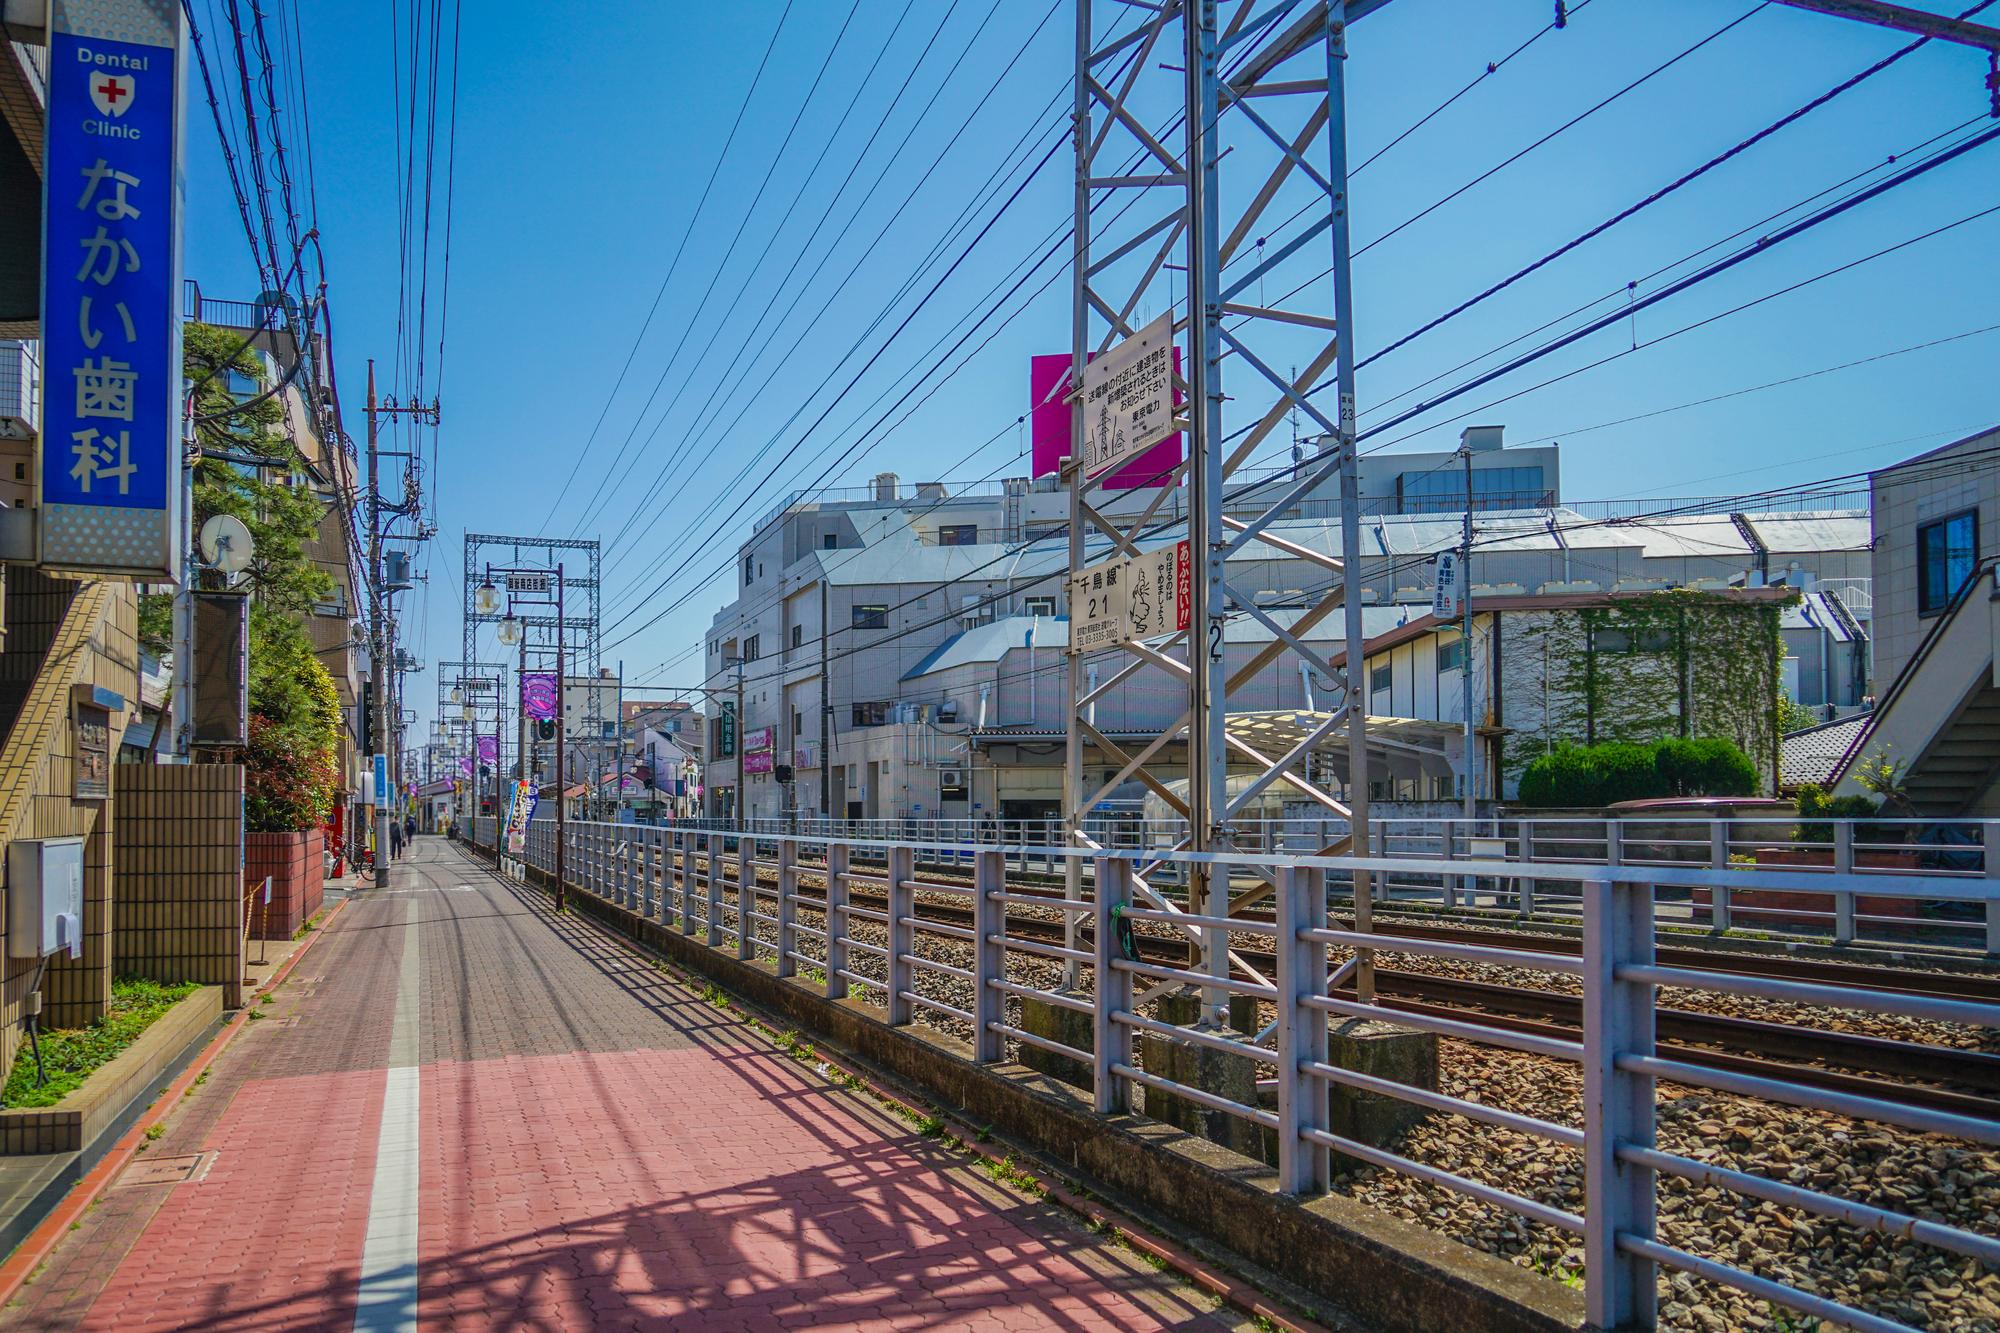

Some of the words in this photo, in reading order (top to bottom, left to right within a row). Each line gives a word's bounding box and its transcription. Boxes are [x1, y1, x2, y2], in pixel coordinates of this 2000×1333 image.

[77, 47, 148, 71] Dental
[82, 119, 141, 139] Clinic
[70, 158, 141, 495] なかい歯科
[1088, 346, 1166, 403] 送電線の付近に建造物を
[1120, 377, 1166, 412] お知らせ下さい
[1132, 400, 1160, 423] 東京電力
[1342, 407, 1353, 421] 23
[1088, 594, 1108, 619] 21
[1209, 625, 1221, 658] 2
